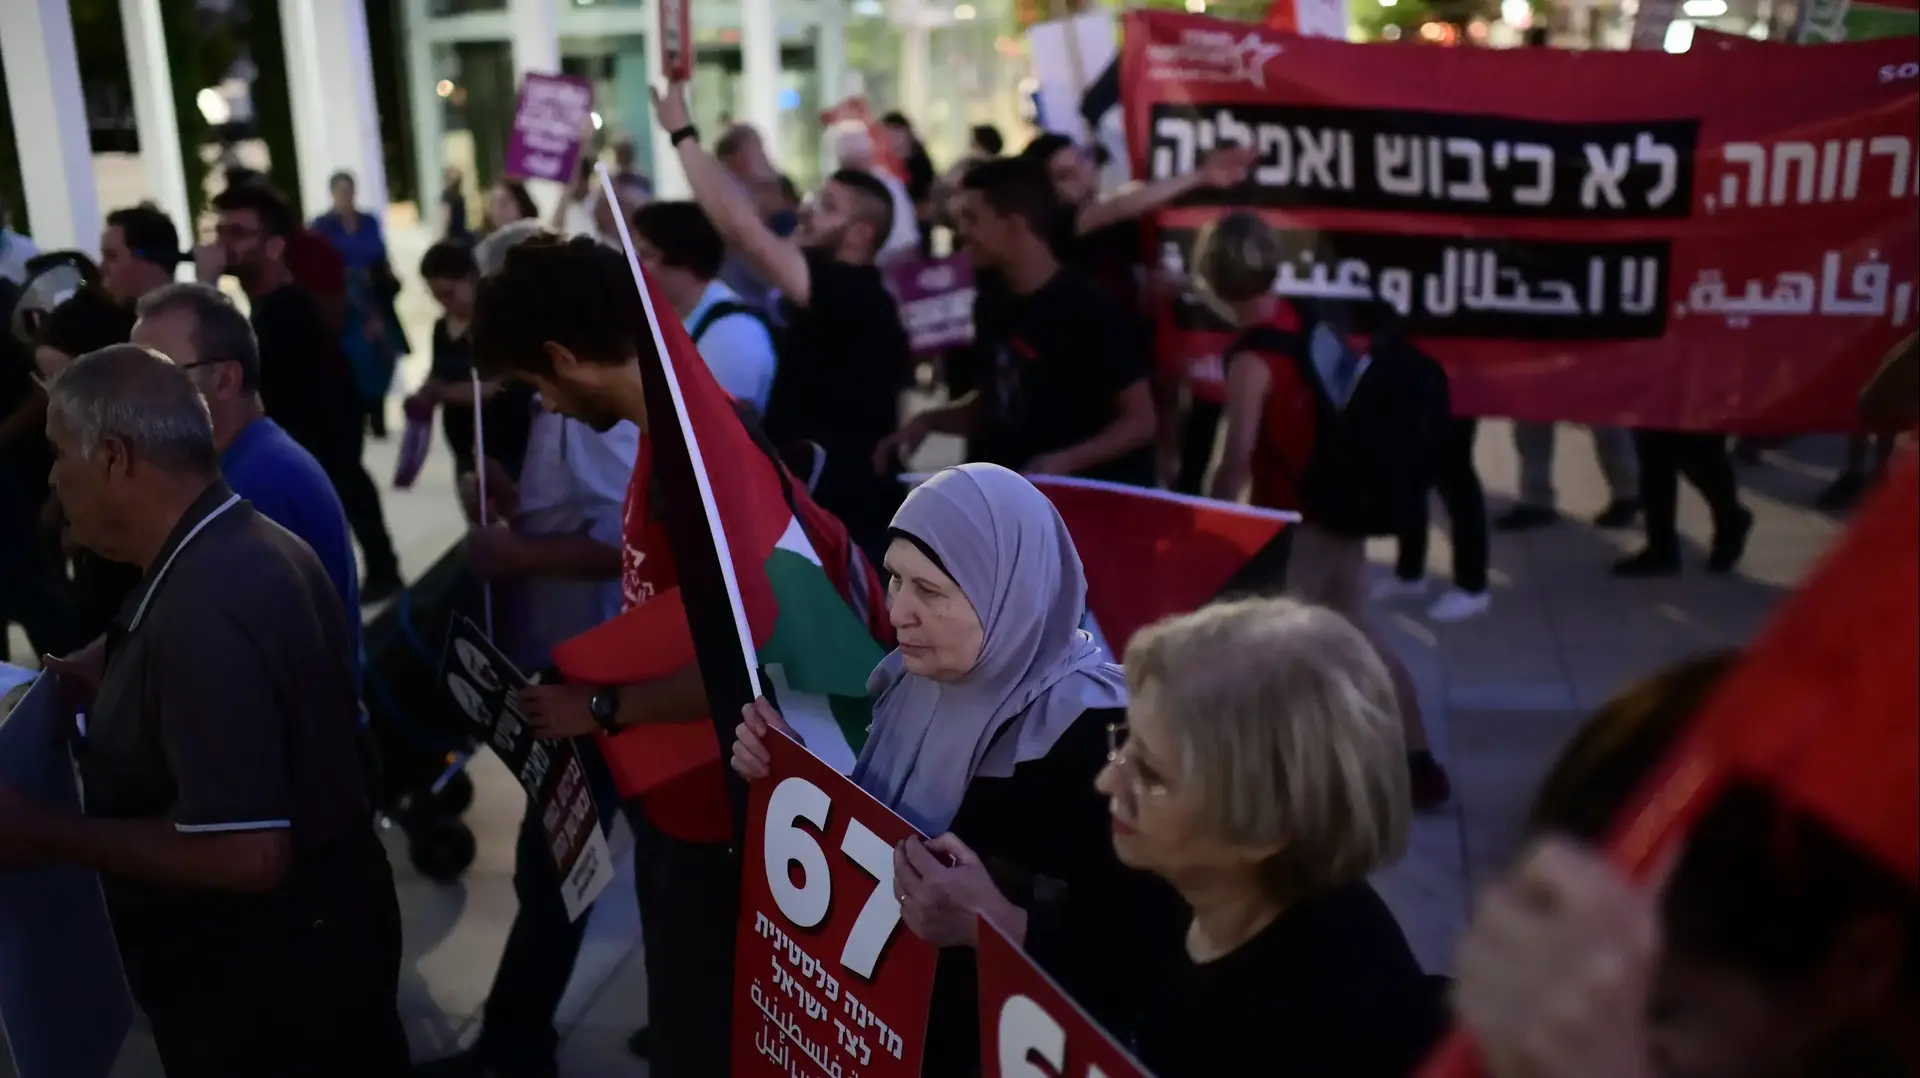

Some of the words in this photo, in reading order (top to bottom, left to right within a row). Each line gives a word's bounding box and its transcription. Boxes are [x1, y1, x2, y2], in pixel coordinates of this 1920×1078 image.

[1375, 133, 1554, 206] כיבוש
[1581, 131, 1677, 209] לא
[1619, 257, 1658, 315] لا
[764, 776, 903, 980] 67
[754, 910, 840, 1002] פלסטינית
[771, 955, 828, 1021] ישראל
[833, 1017, 872, 1066] לצד
[844, 990, 903, 1060] מדינה
